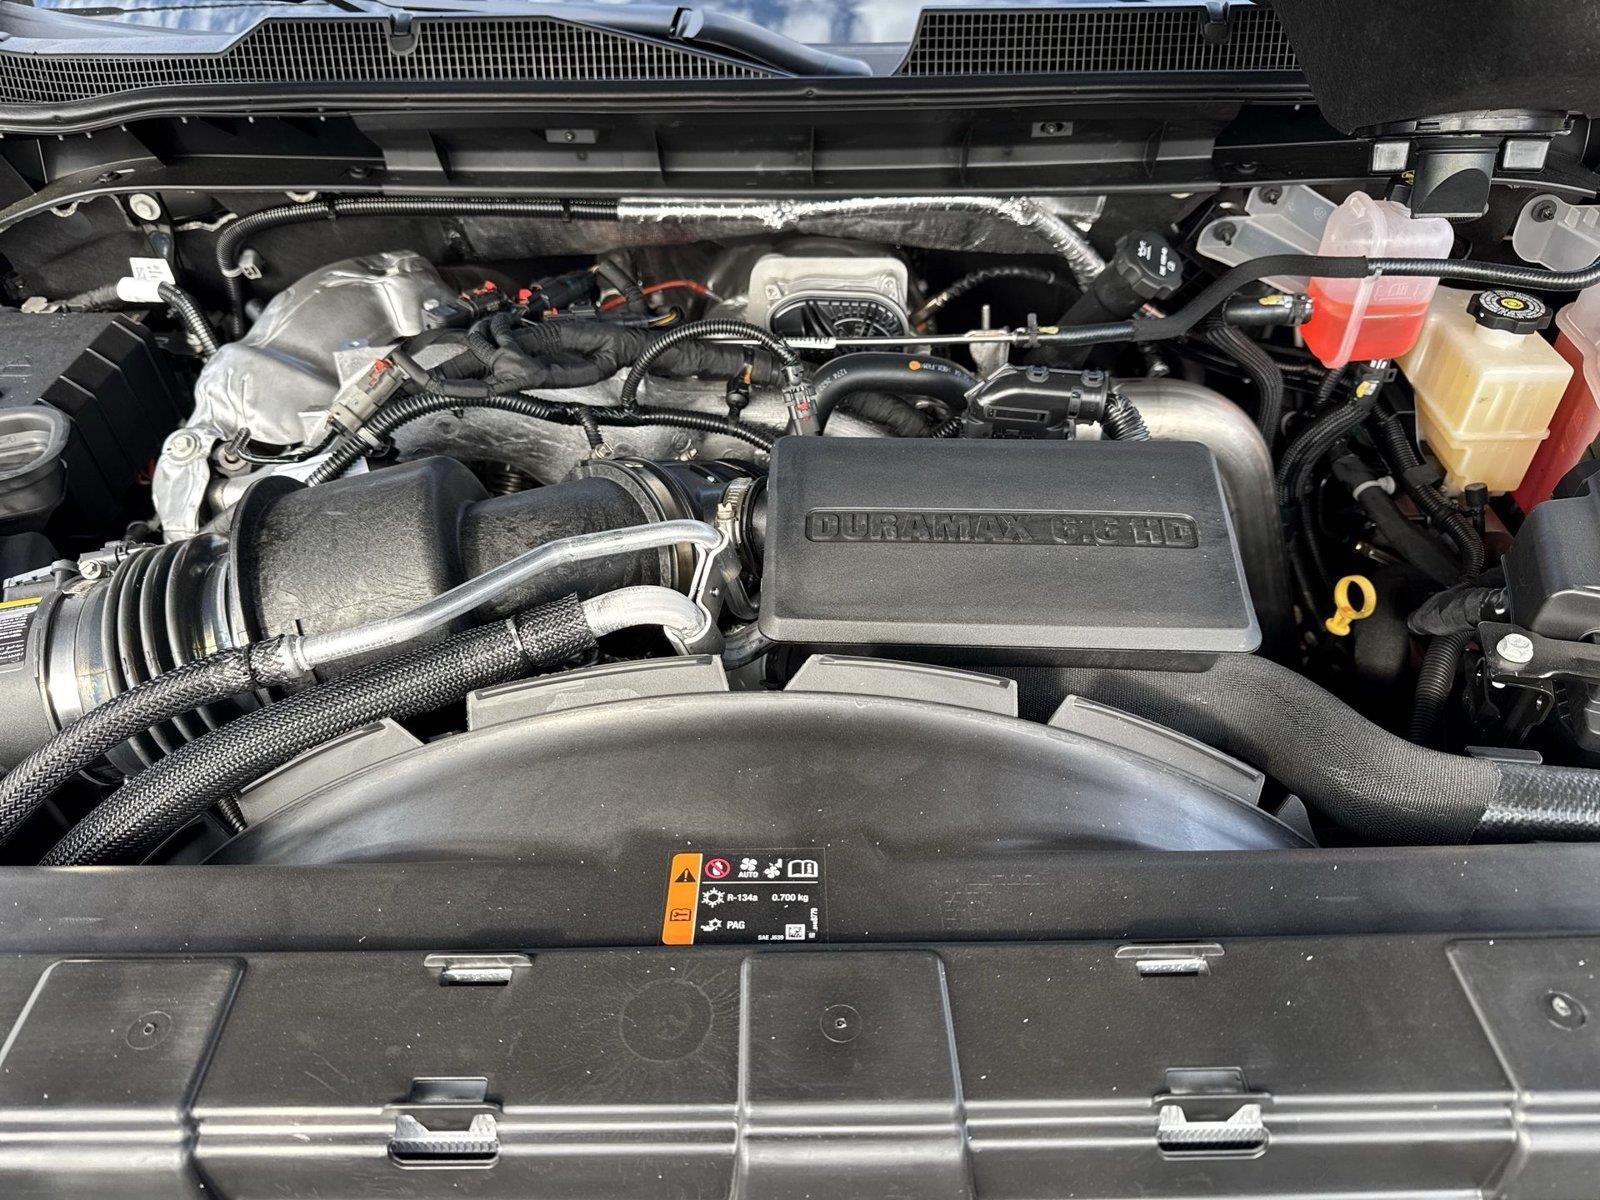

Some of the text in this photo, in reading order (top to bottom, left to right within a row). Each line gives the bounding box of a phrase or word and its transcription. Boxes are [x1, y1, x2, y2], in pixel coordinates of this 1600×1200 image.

[810, 513, 1195, 546] DURAMAX 6.6 HD
[727, 893, 809, 903] R-134a 0.700 kg
[726, 920, 746, 930] PAG
